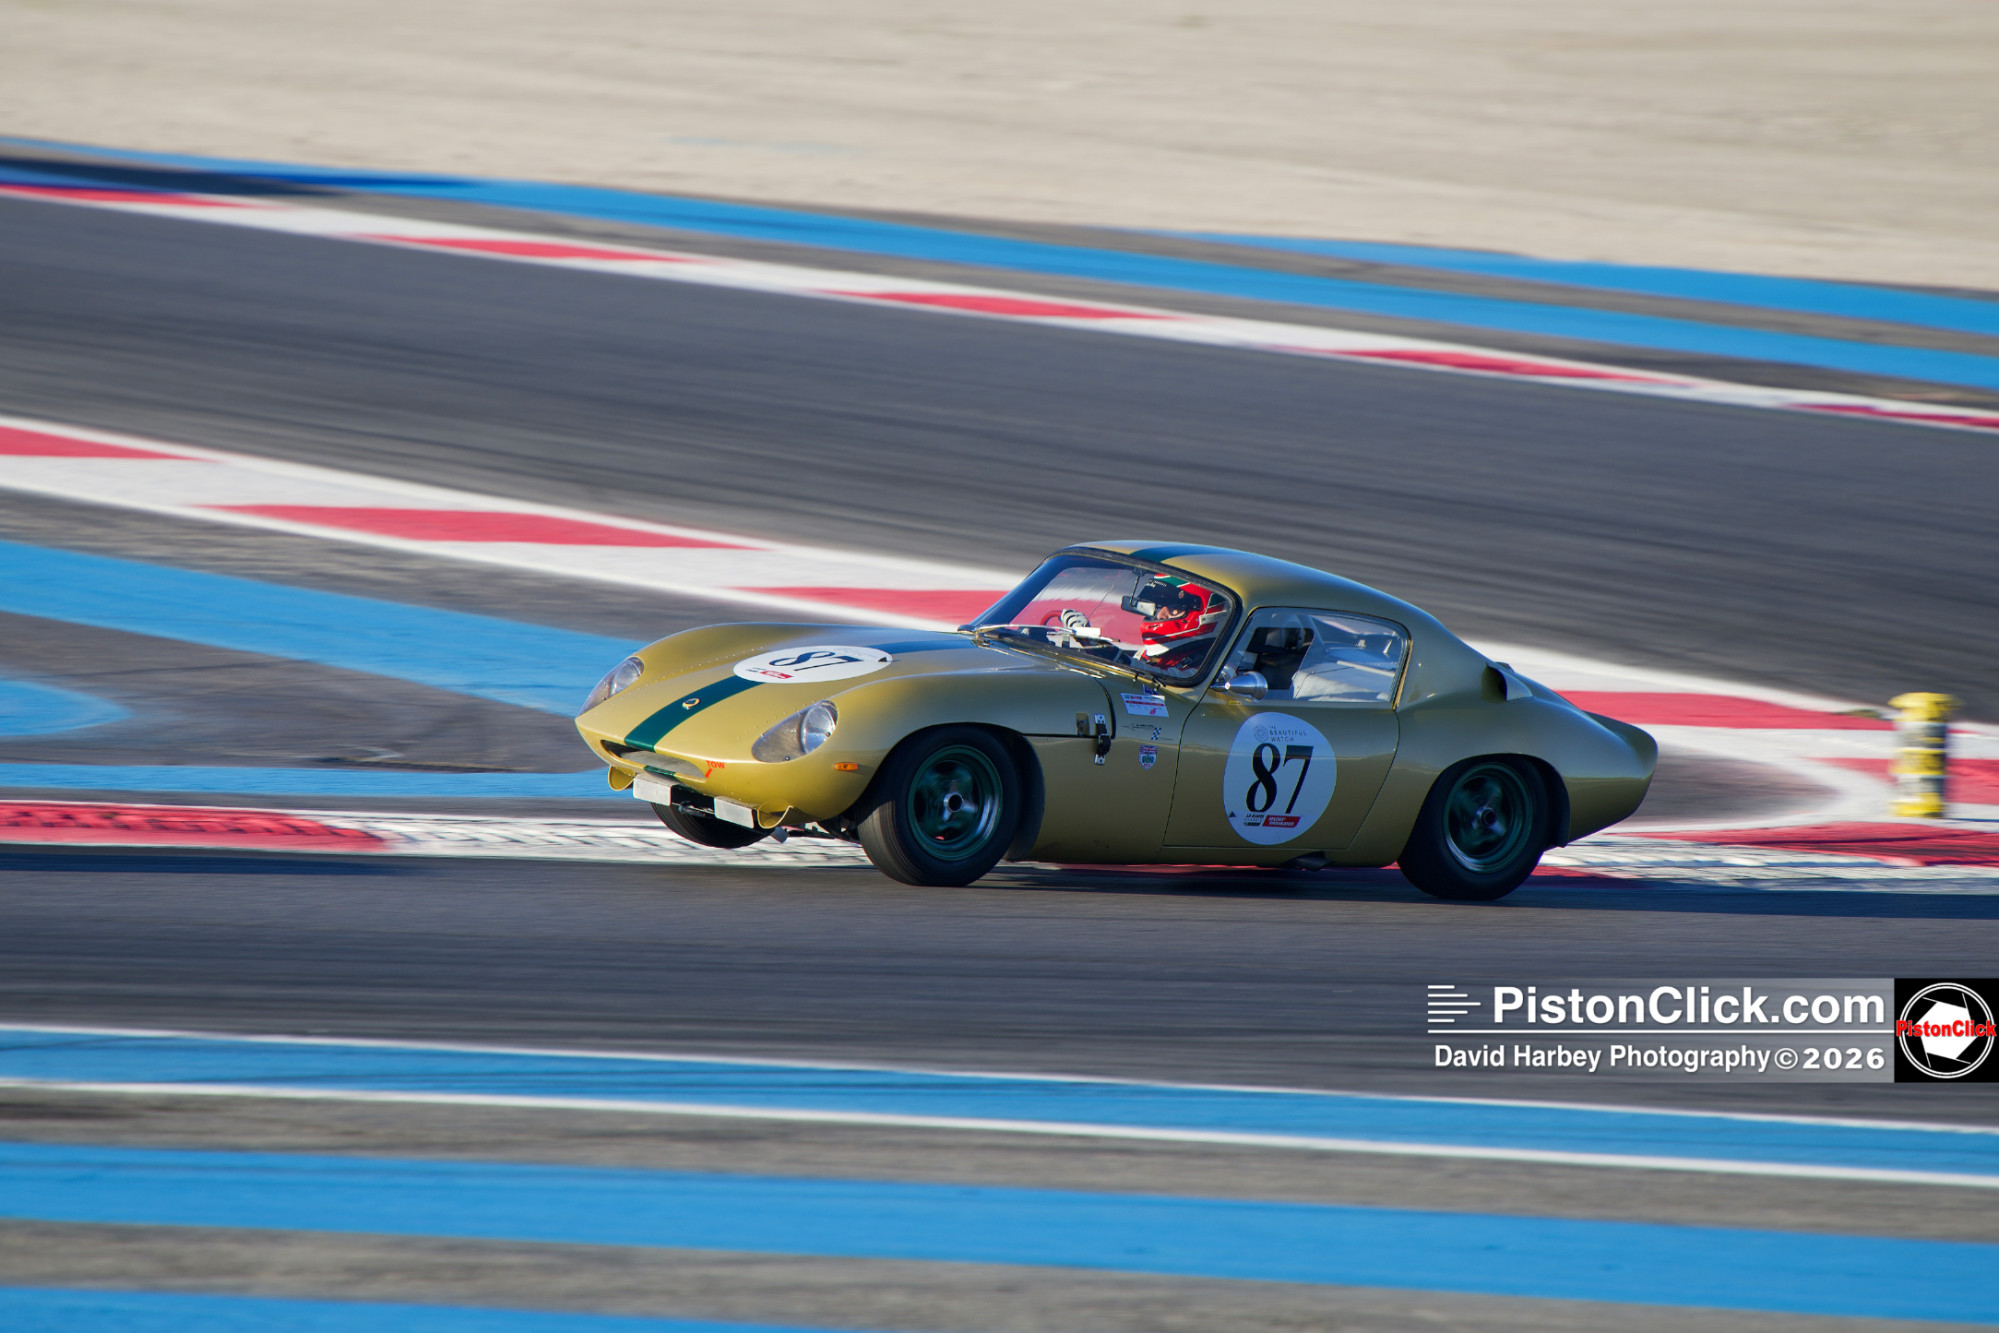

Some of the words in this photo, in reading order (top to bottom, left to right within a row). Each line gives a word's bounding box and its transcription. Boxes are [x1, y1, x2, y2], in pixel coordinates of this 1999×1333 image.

[769, 650, 864, 672] 87
[705, 760, 726, 769] TOW
[1245, 743, 1314, 814] 87
